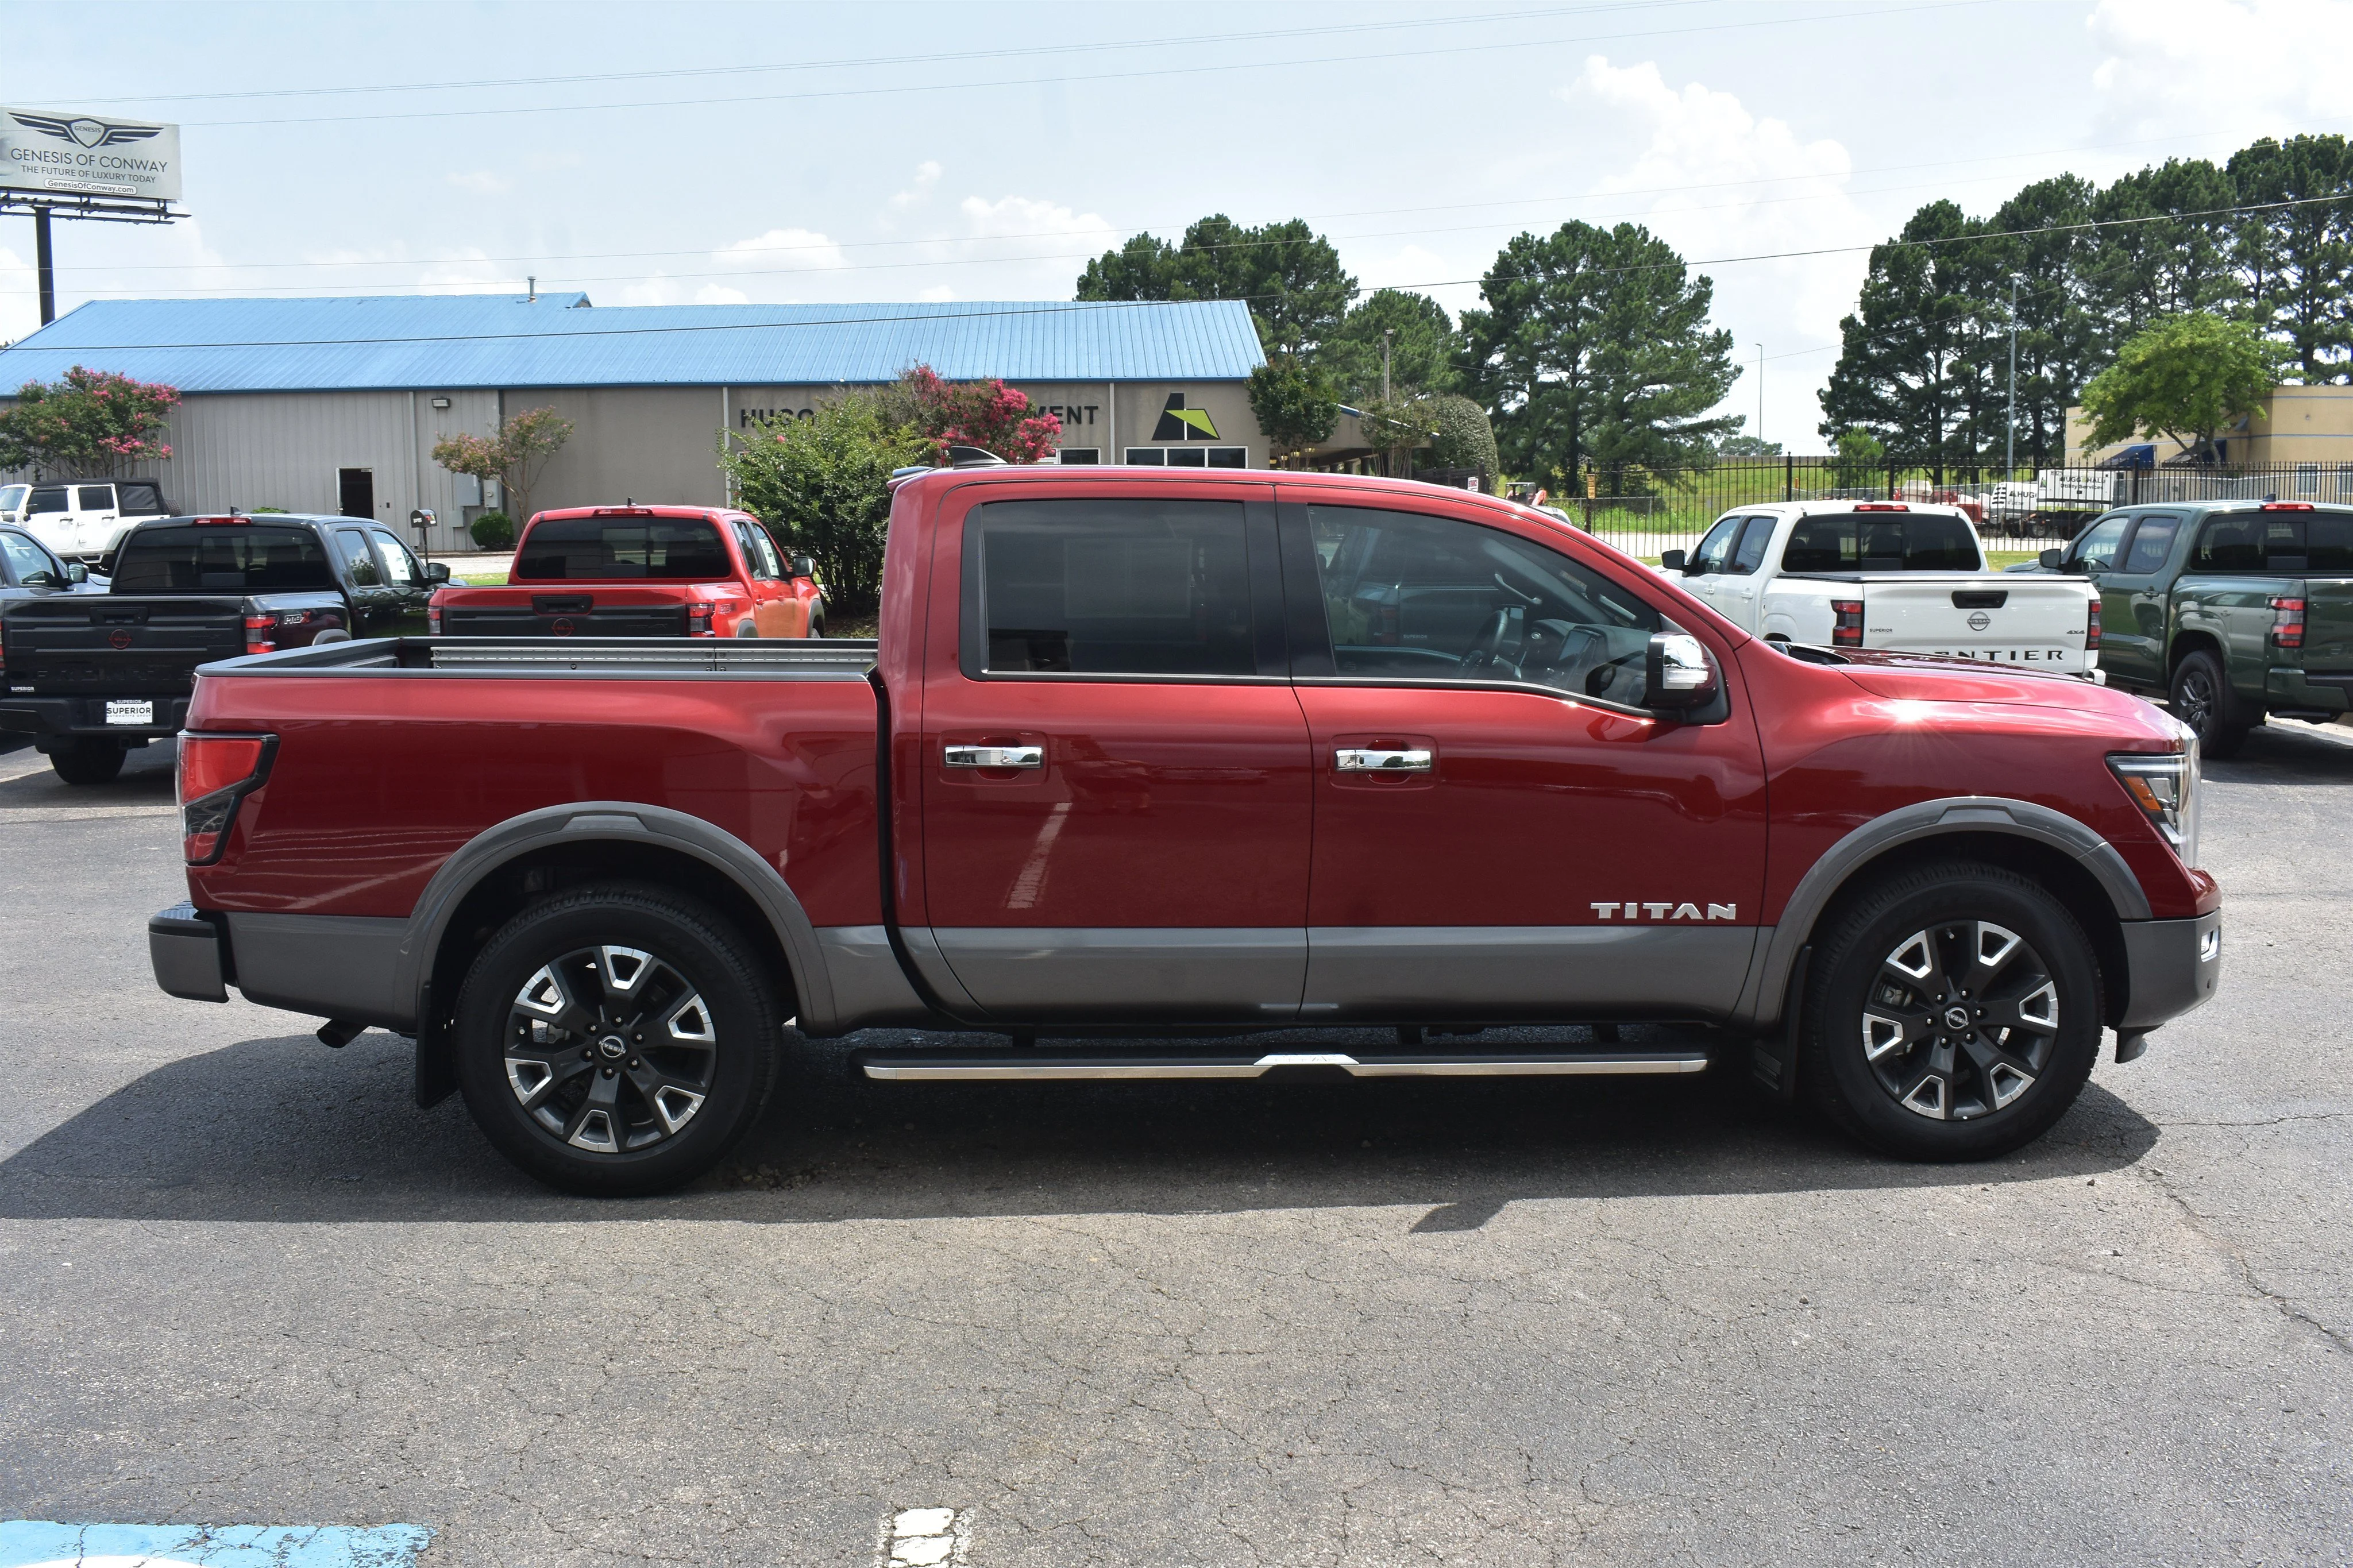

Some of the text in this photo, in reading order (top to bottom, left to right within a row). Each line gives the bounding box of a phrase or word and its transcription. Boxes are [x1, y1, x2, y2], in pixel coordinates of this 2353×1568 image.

[10, 148, 168, 172] GENESIS OF CONWAY
[21, 165, 39, 173] THE
[41, 167, 76, 176] FUTURE
[92, 171, 126, 180] LUXURY
[128, 174, 156, 183] TODAY
[48, 180, 134, 193] GenesisOfConway.com
[1590, 902, 1737, 920] TITAN
